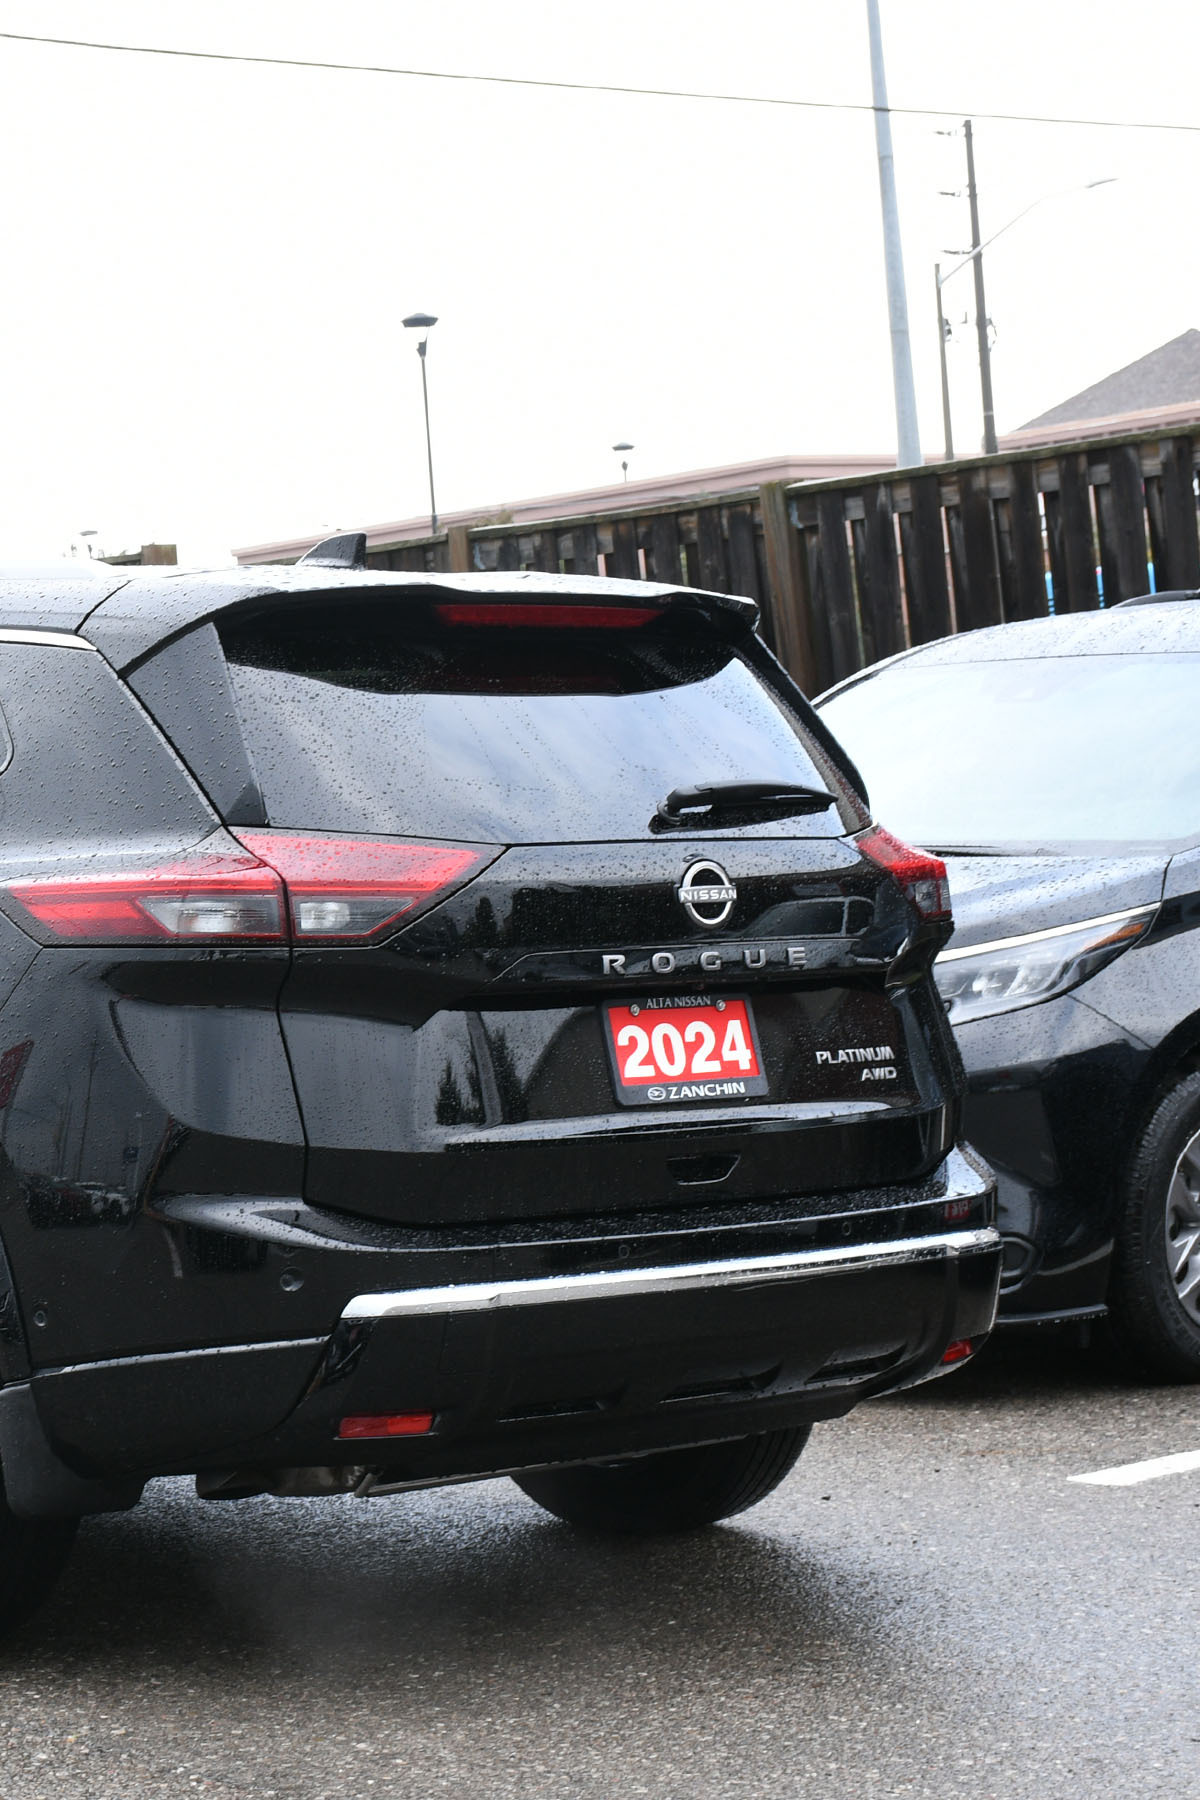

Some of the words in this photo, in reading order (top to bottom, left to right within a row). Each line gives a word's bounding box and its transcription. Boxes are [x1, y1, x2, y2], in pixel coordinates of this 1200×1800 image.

[680, 887, 737, 902] NISSAN
[602, 947, 808, 975] ROGUE
[646, 997, 673, 1009] ALTA
[674, 995, 711, 1007] NISSAN
[617, 1019, 752, 1078] 2024
[815, 1045, 895, 1065] PLATINUM
[861, 1066, 897, 1081] AWD
[667, 1081, 746, 1099] ZANCHIN
